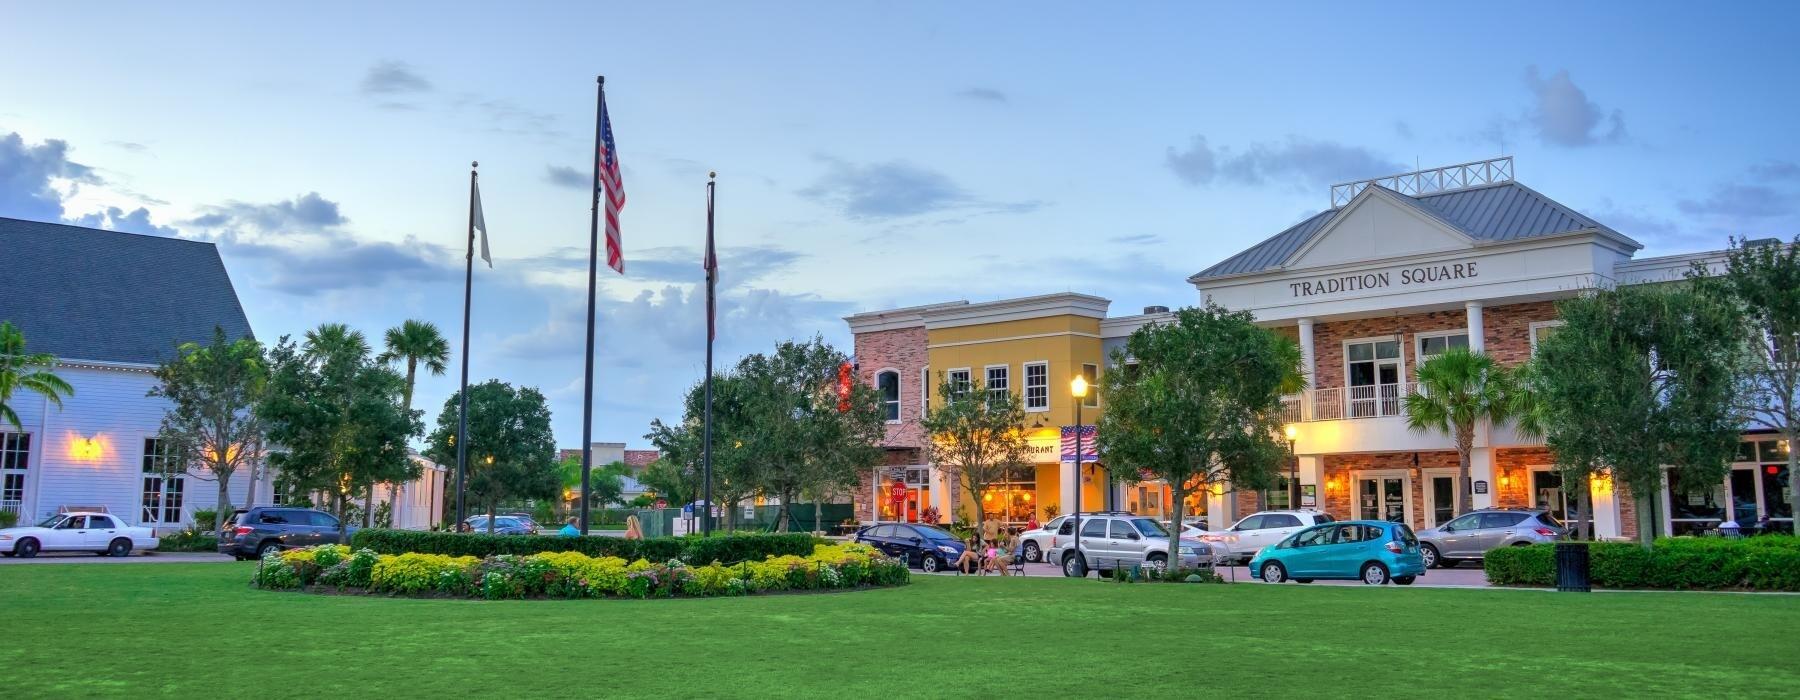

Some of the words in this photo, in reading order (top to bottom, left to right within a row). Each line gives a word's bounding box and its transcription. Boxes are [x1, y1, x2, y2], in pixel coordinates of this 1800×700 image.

[1290, 272, 1390, 297] TRADITION
[1401, 262, 1478, 285] SQUARE
[1010, 445, 1054, 455] STAURANT
[892, 487, 906, 496] STOP
